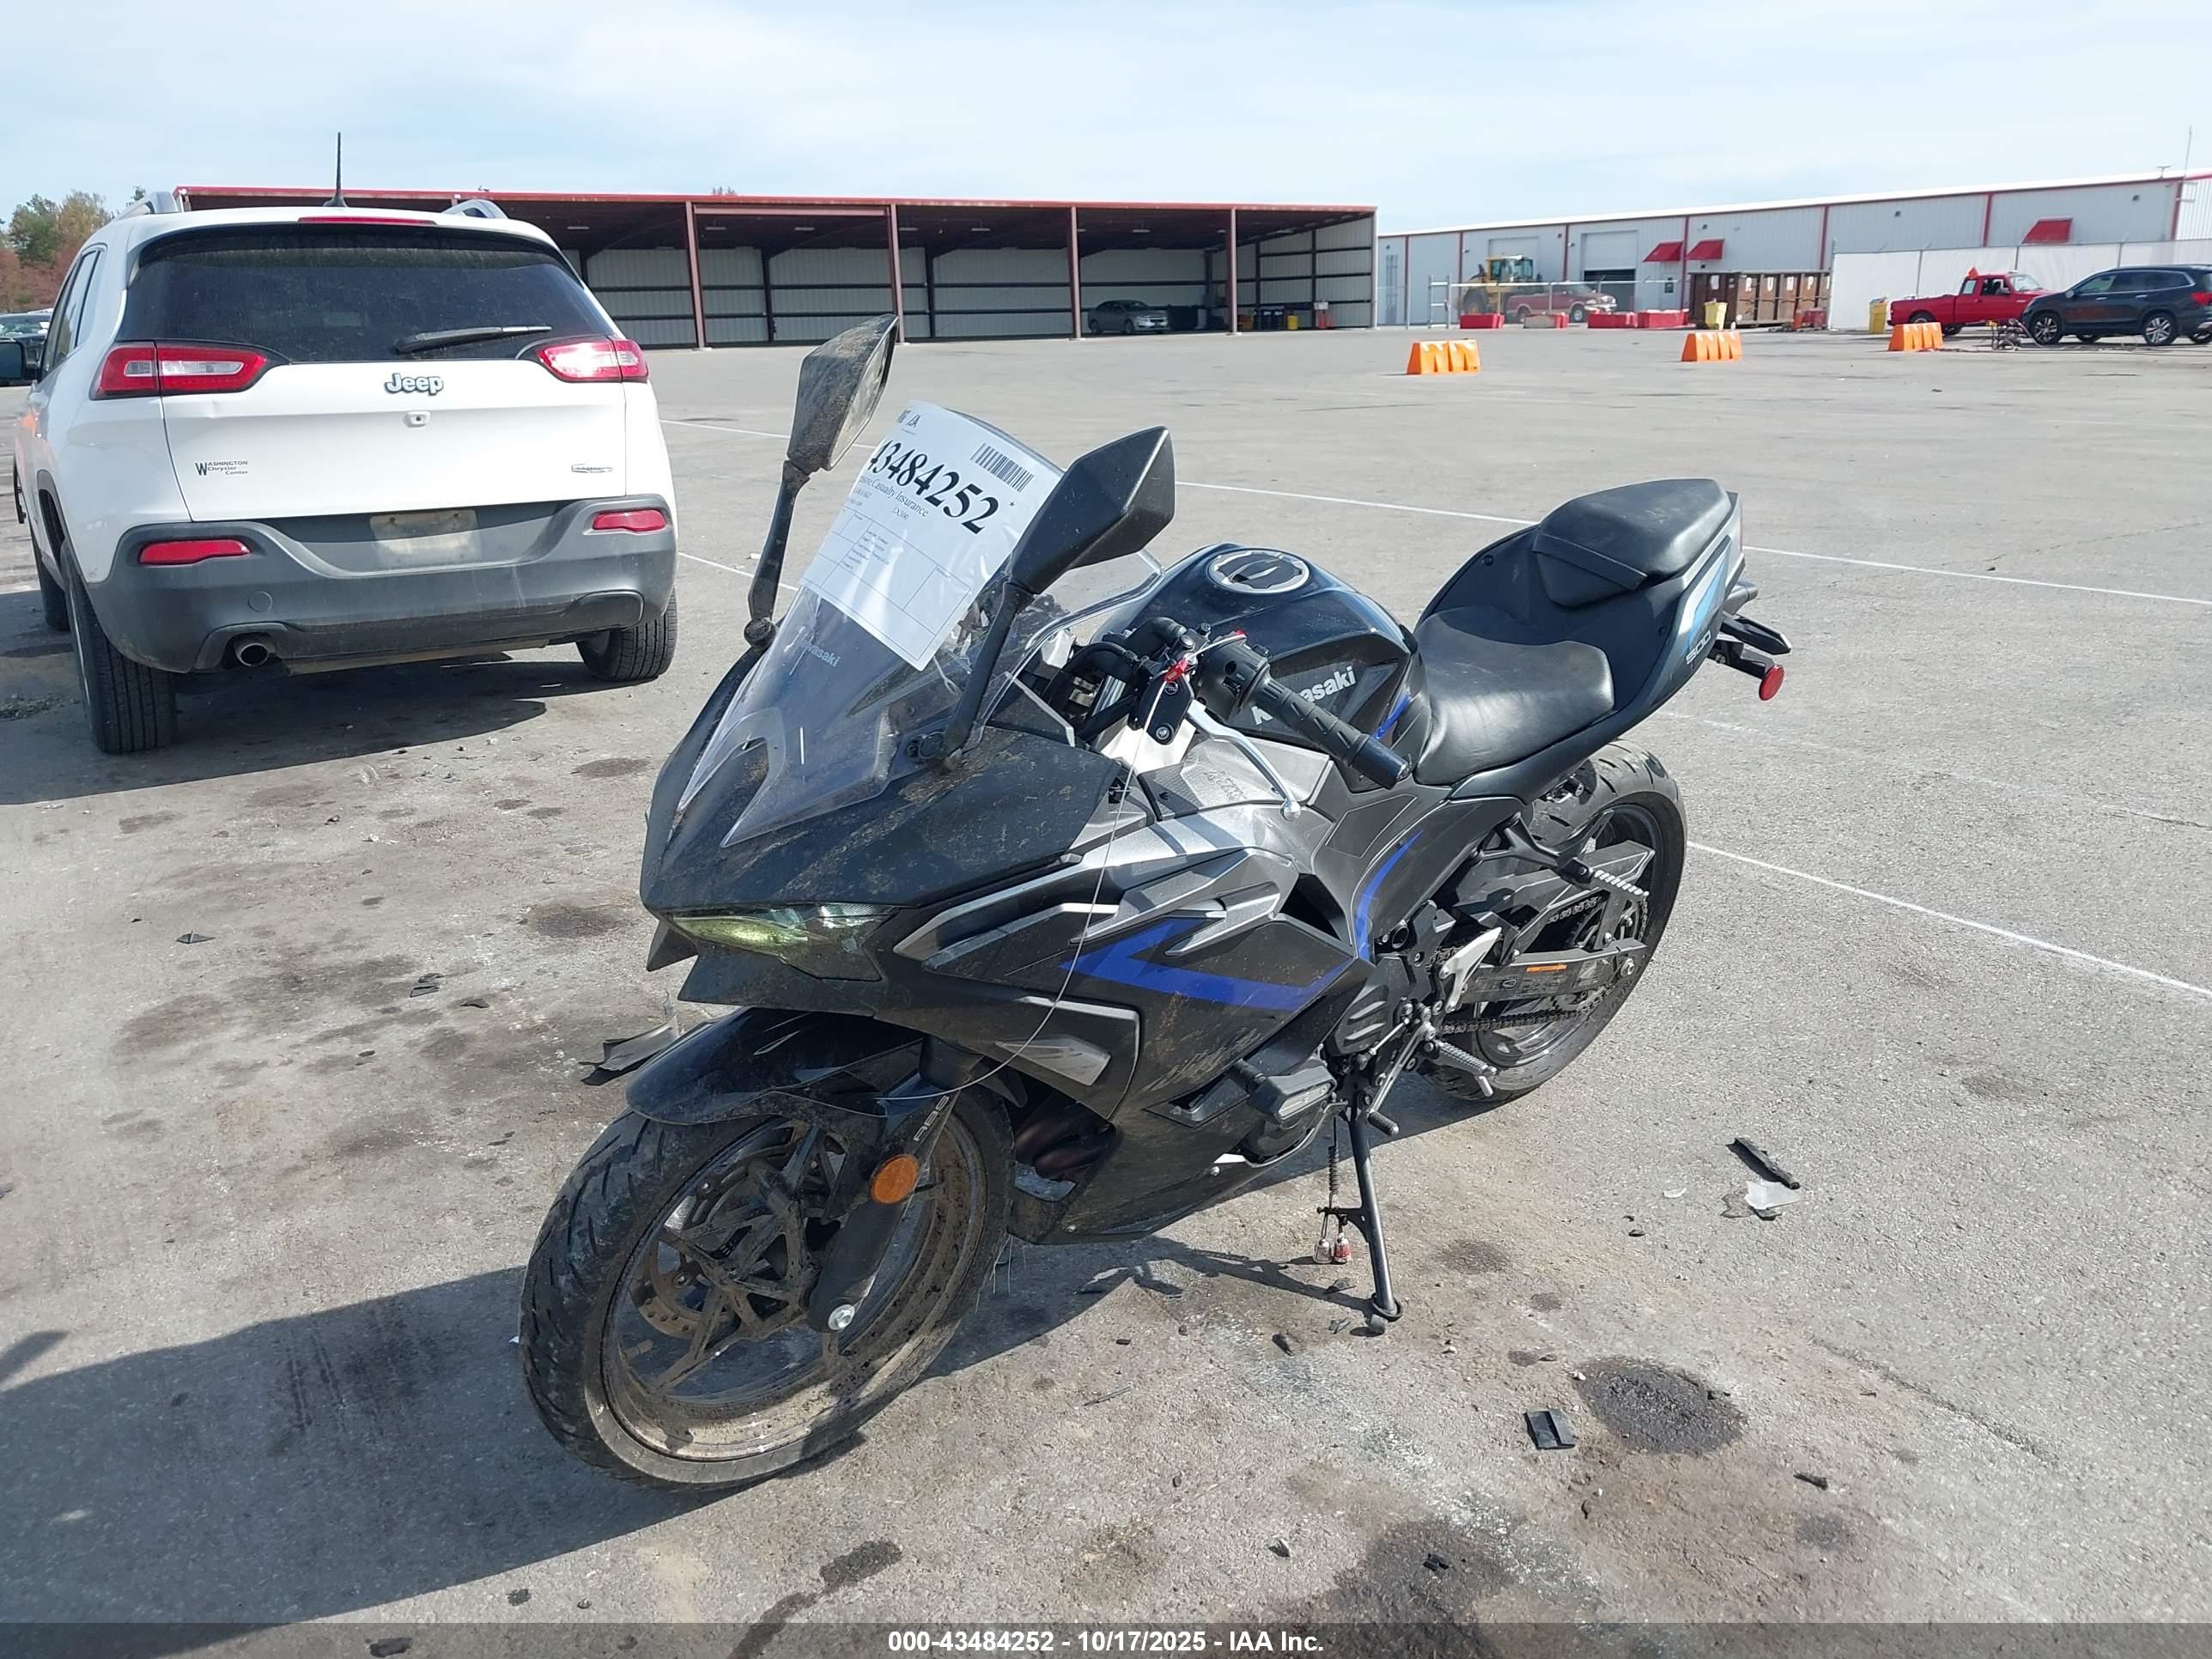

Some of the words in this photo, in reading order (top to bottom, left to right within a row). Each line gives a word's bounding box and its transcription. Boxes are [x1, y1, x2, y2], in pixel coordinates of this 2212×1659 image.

[384, 373, 444, 396] Jeep
[195, 460, 248, 476] WASHINGTON
[872, 479, 895, 499] Casualty
[895, 491, 929, 517] Insurance
[1686, 630, 1711, 665] 500
[1251, 665, 1357, 726] Kasaki
[913, 1095, 950, 1141] ABS
